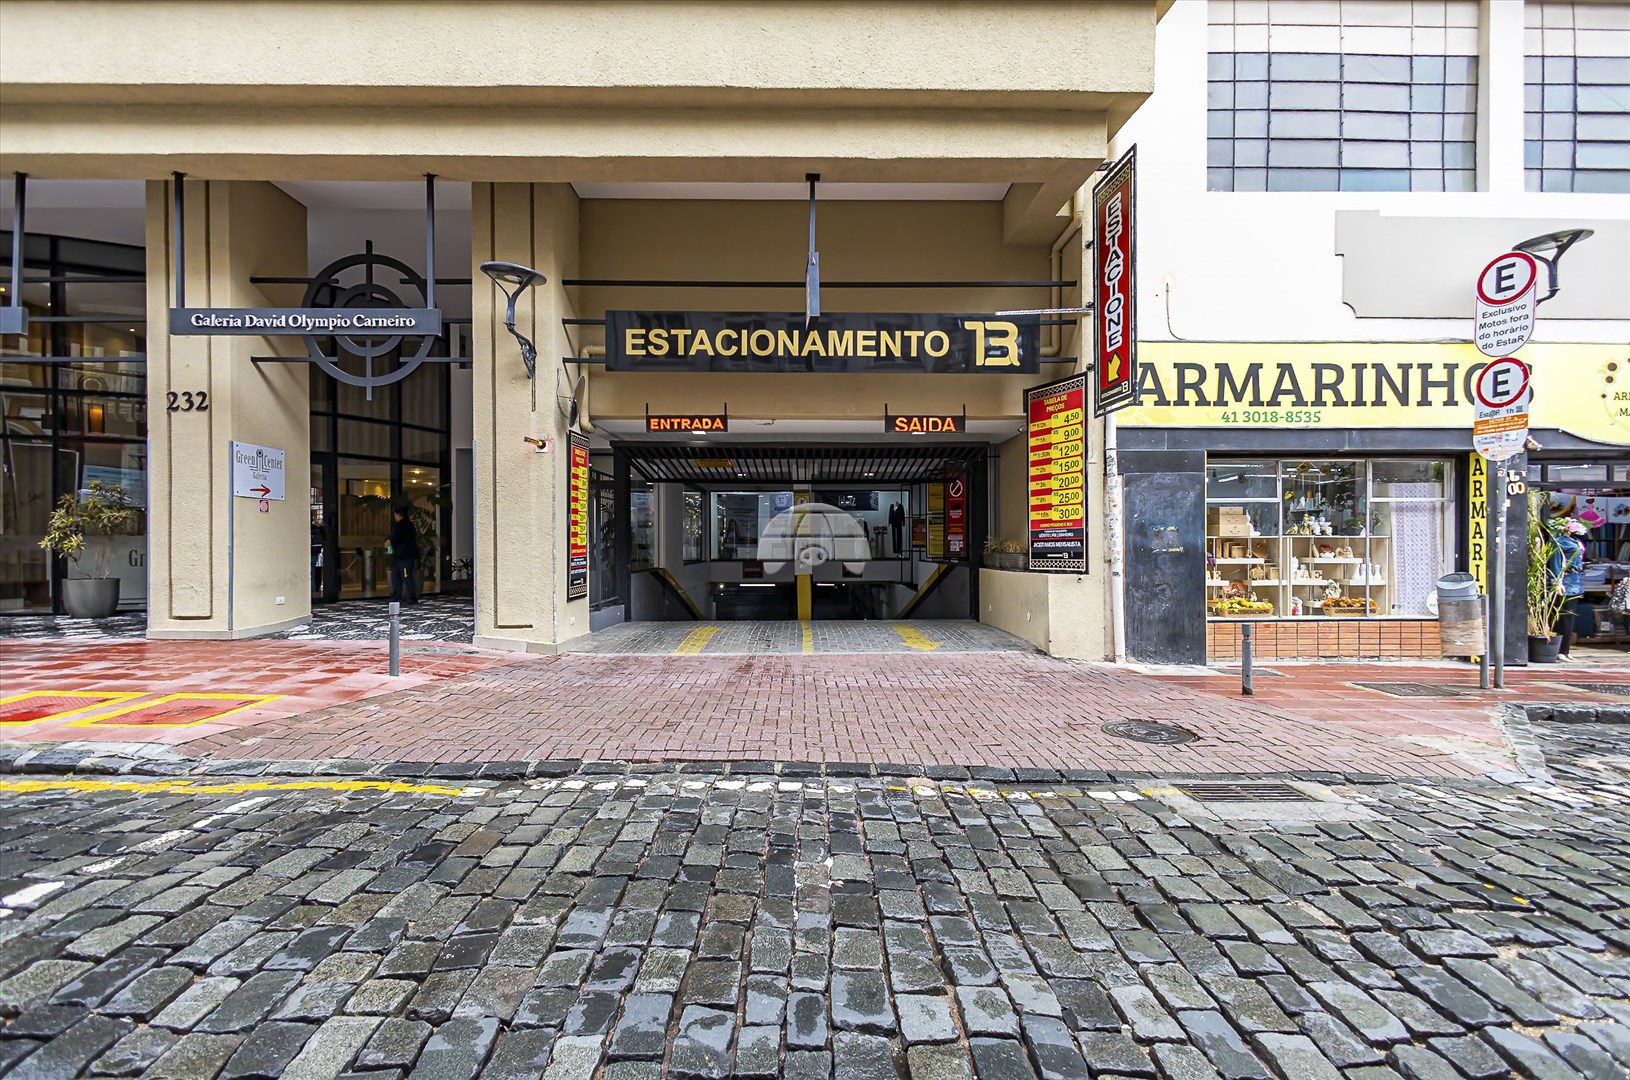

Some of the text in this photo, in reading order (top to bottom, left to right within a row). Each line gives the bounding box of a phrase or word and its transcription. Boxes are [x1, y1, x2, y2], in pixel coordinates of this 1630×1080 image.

[1106, 193, 1123, 351] ESTACIONE
[1495, 262, 1516, 294] E
[1482, 303, 1527, 319] Exclusivo
[190, 313, 416, 331] Galeria David Olympio Carneiro
[1478, 313, 1529, 331] Motos fora
[1478, 325, 1529, 341] do horário
[625, 328, 950, 357] ESTACIONAMENTO
[1481, 334, 1525, 351] do EstaR
[1138, 362, 1534, 407] ARMARINH
[1492, 368, 1511, 398] E
[166, 391, 209, 412] 232
[649, 418, 725, 431] ENTRADA
[895, 416, 957, 433] SAIDA
[1221, 411, 1322, 425] 41 3018-8535
[236, 451, 283, 470] Green Center
